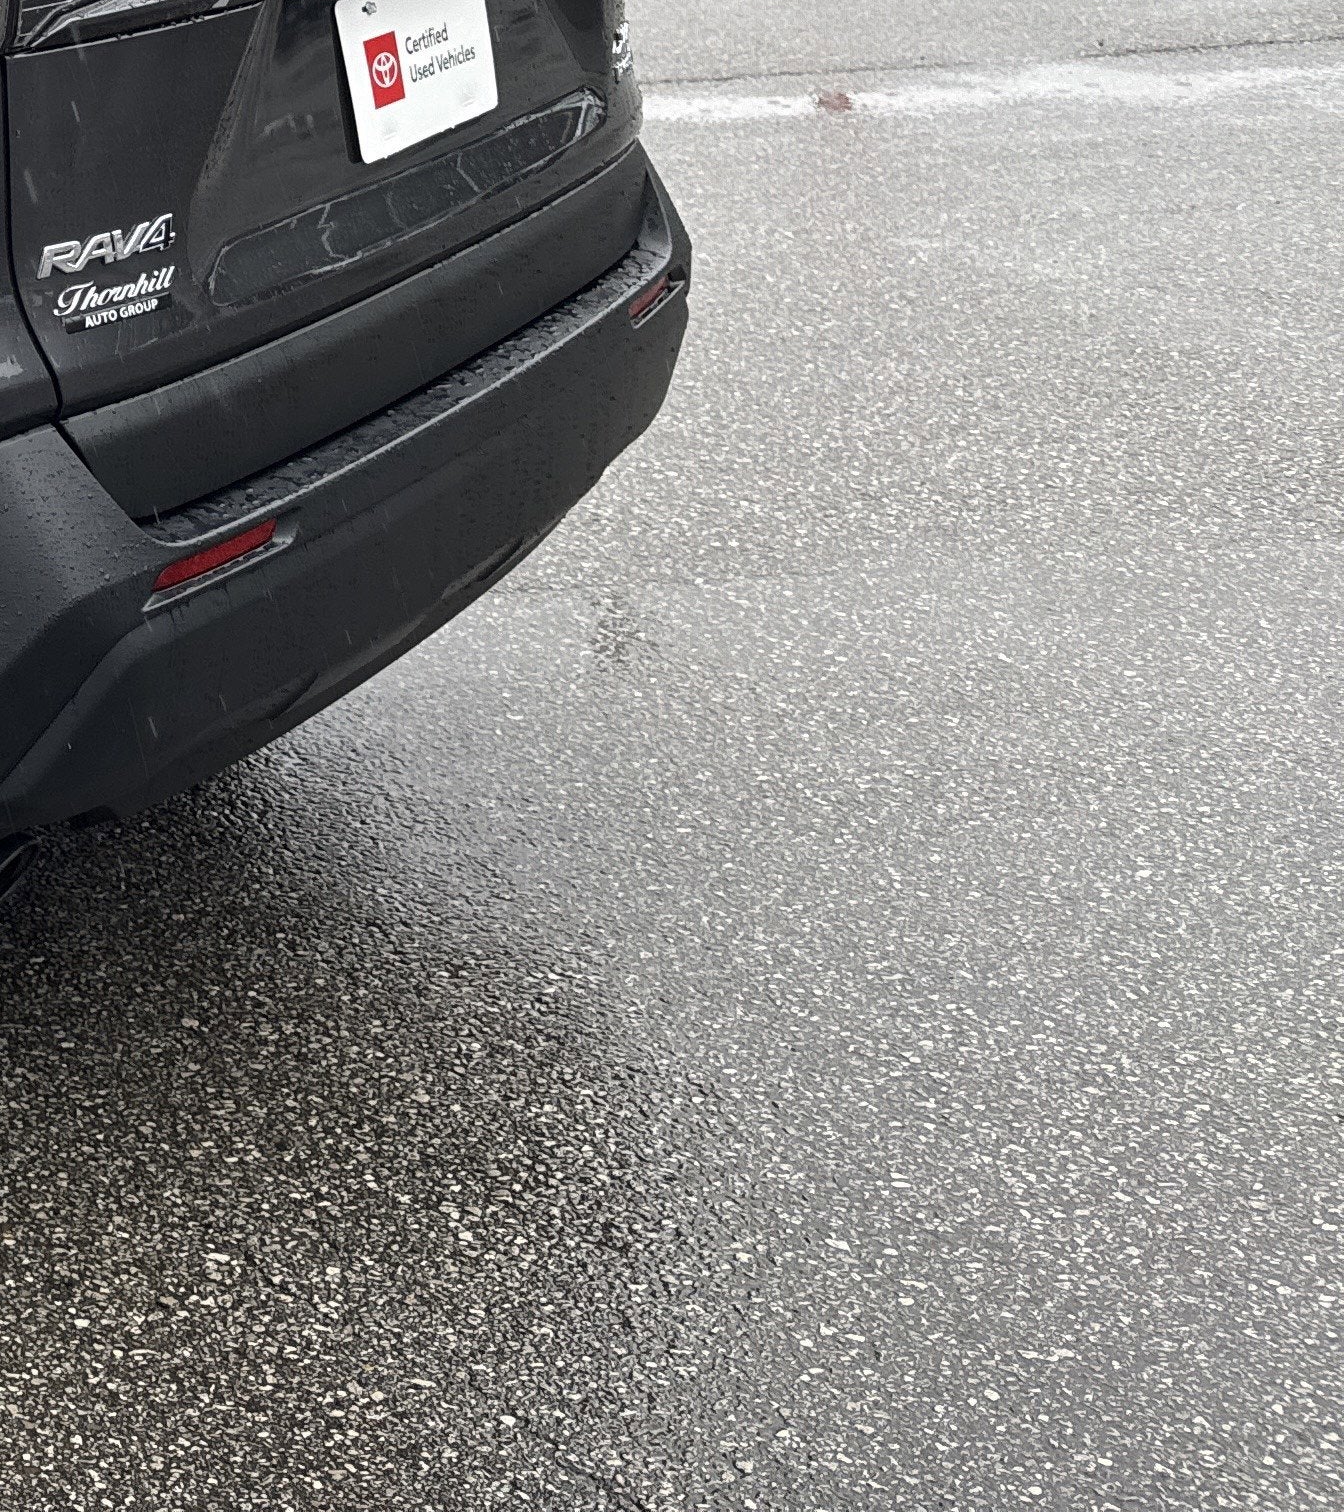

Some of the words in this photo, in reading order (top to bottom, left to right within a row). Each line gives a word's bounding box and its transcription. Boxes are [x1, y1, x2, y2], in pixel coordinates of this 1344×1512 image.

[405, 22, 449, 54] Certified
[409, 55, 436, 83] Used
[435, 44, 476, 73] Vehicles
[37, 213, 176, 279] RAV4
[53, 265, 176, 316] Thornhill
[85, 309, 118, 328] AUTO
[119, 298, 159, 319] GROUP
